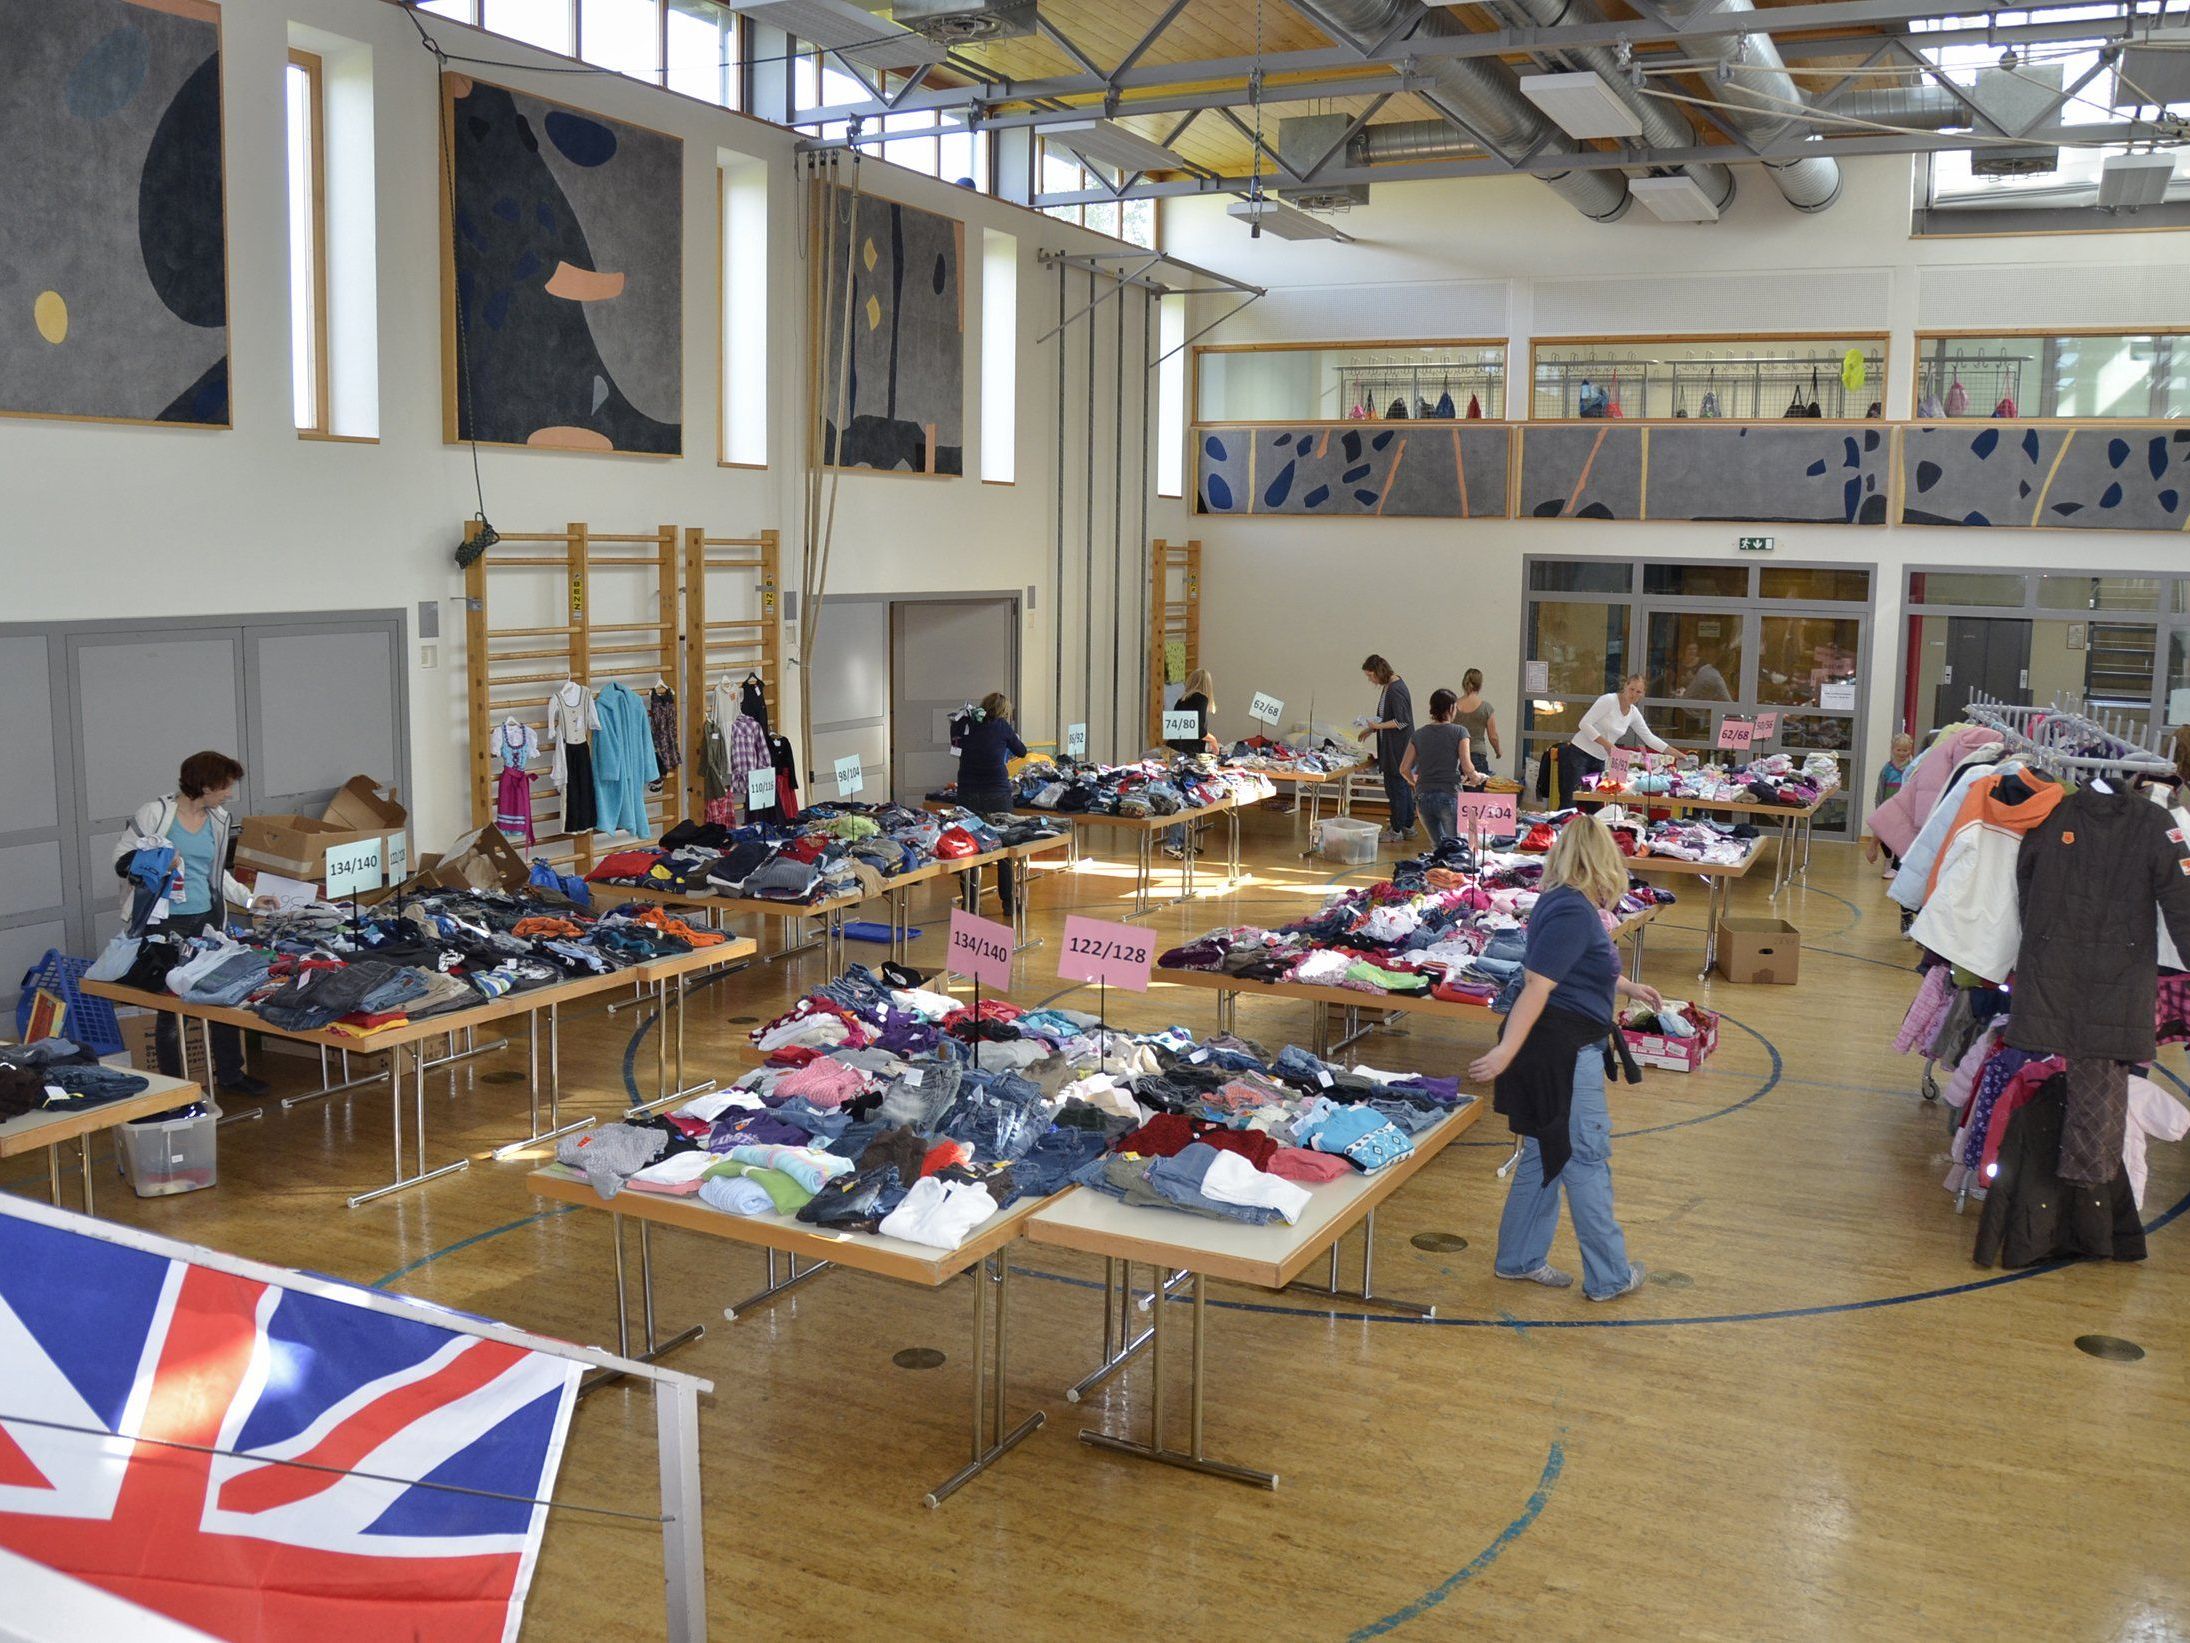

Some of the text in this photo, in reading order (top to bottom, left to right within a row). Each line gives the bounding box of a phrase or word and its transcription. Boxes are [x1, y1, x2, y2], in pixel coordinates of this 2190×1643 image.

[1253, 699, 1279, 717] 62/68
[1165, 718, 1196, 731] 74/80
[1721, 729, 1750, 741] 62/68
[838, 766, 860, 782] 98/104
[751, 781, 774, 794] 110/116
[330, 855, 378, 876] 134/140
[953, 930, 1007, 963] 134/140
[1069, 937, 1147, 964] 122/128
